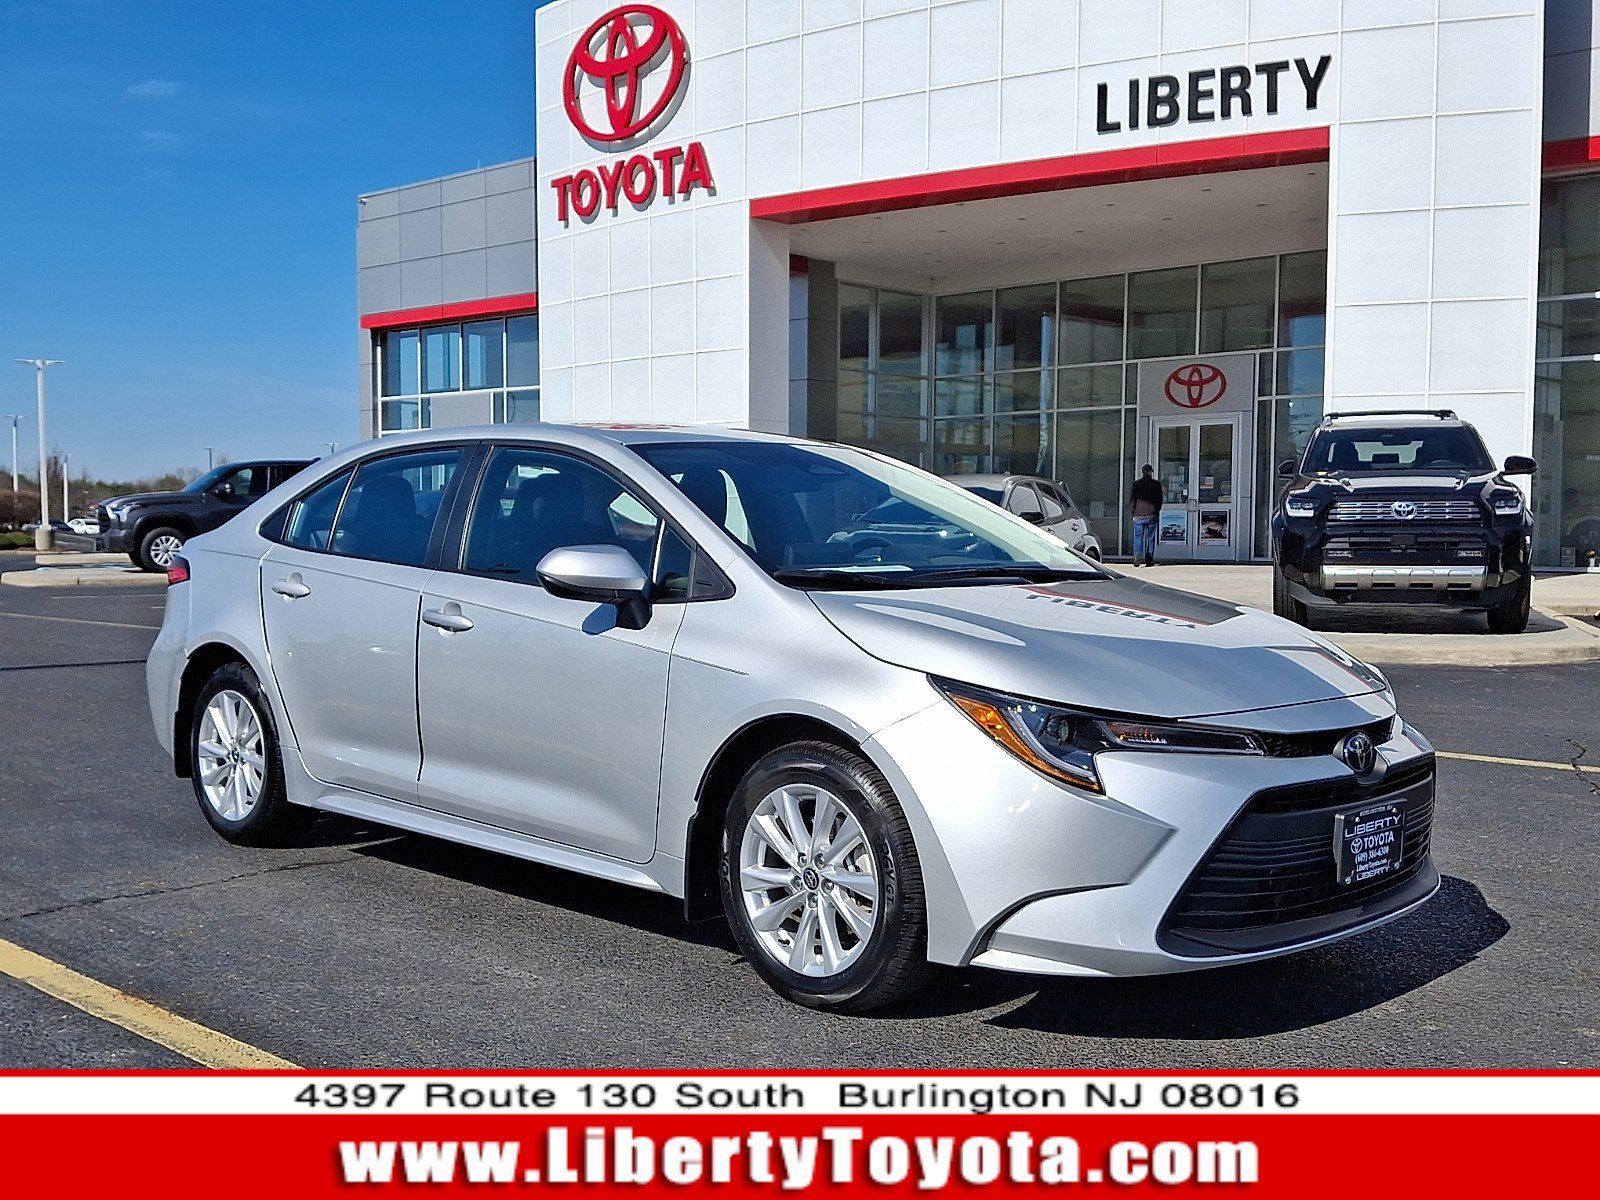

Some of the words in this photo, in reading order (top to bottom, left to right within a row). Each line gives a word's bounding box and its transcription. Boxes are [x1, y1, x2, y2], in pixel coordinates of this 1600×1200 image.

[1096, 54, 1333, 135] LIBERTY
[550, 141, 716, 225] TOYOTA
[1344, 814, 1402, 838] LIBERTY
[1363, 830, 1395, 850] TOYOTA
[1356, 865, 1391, 881] LIBERTY
